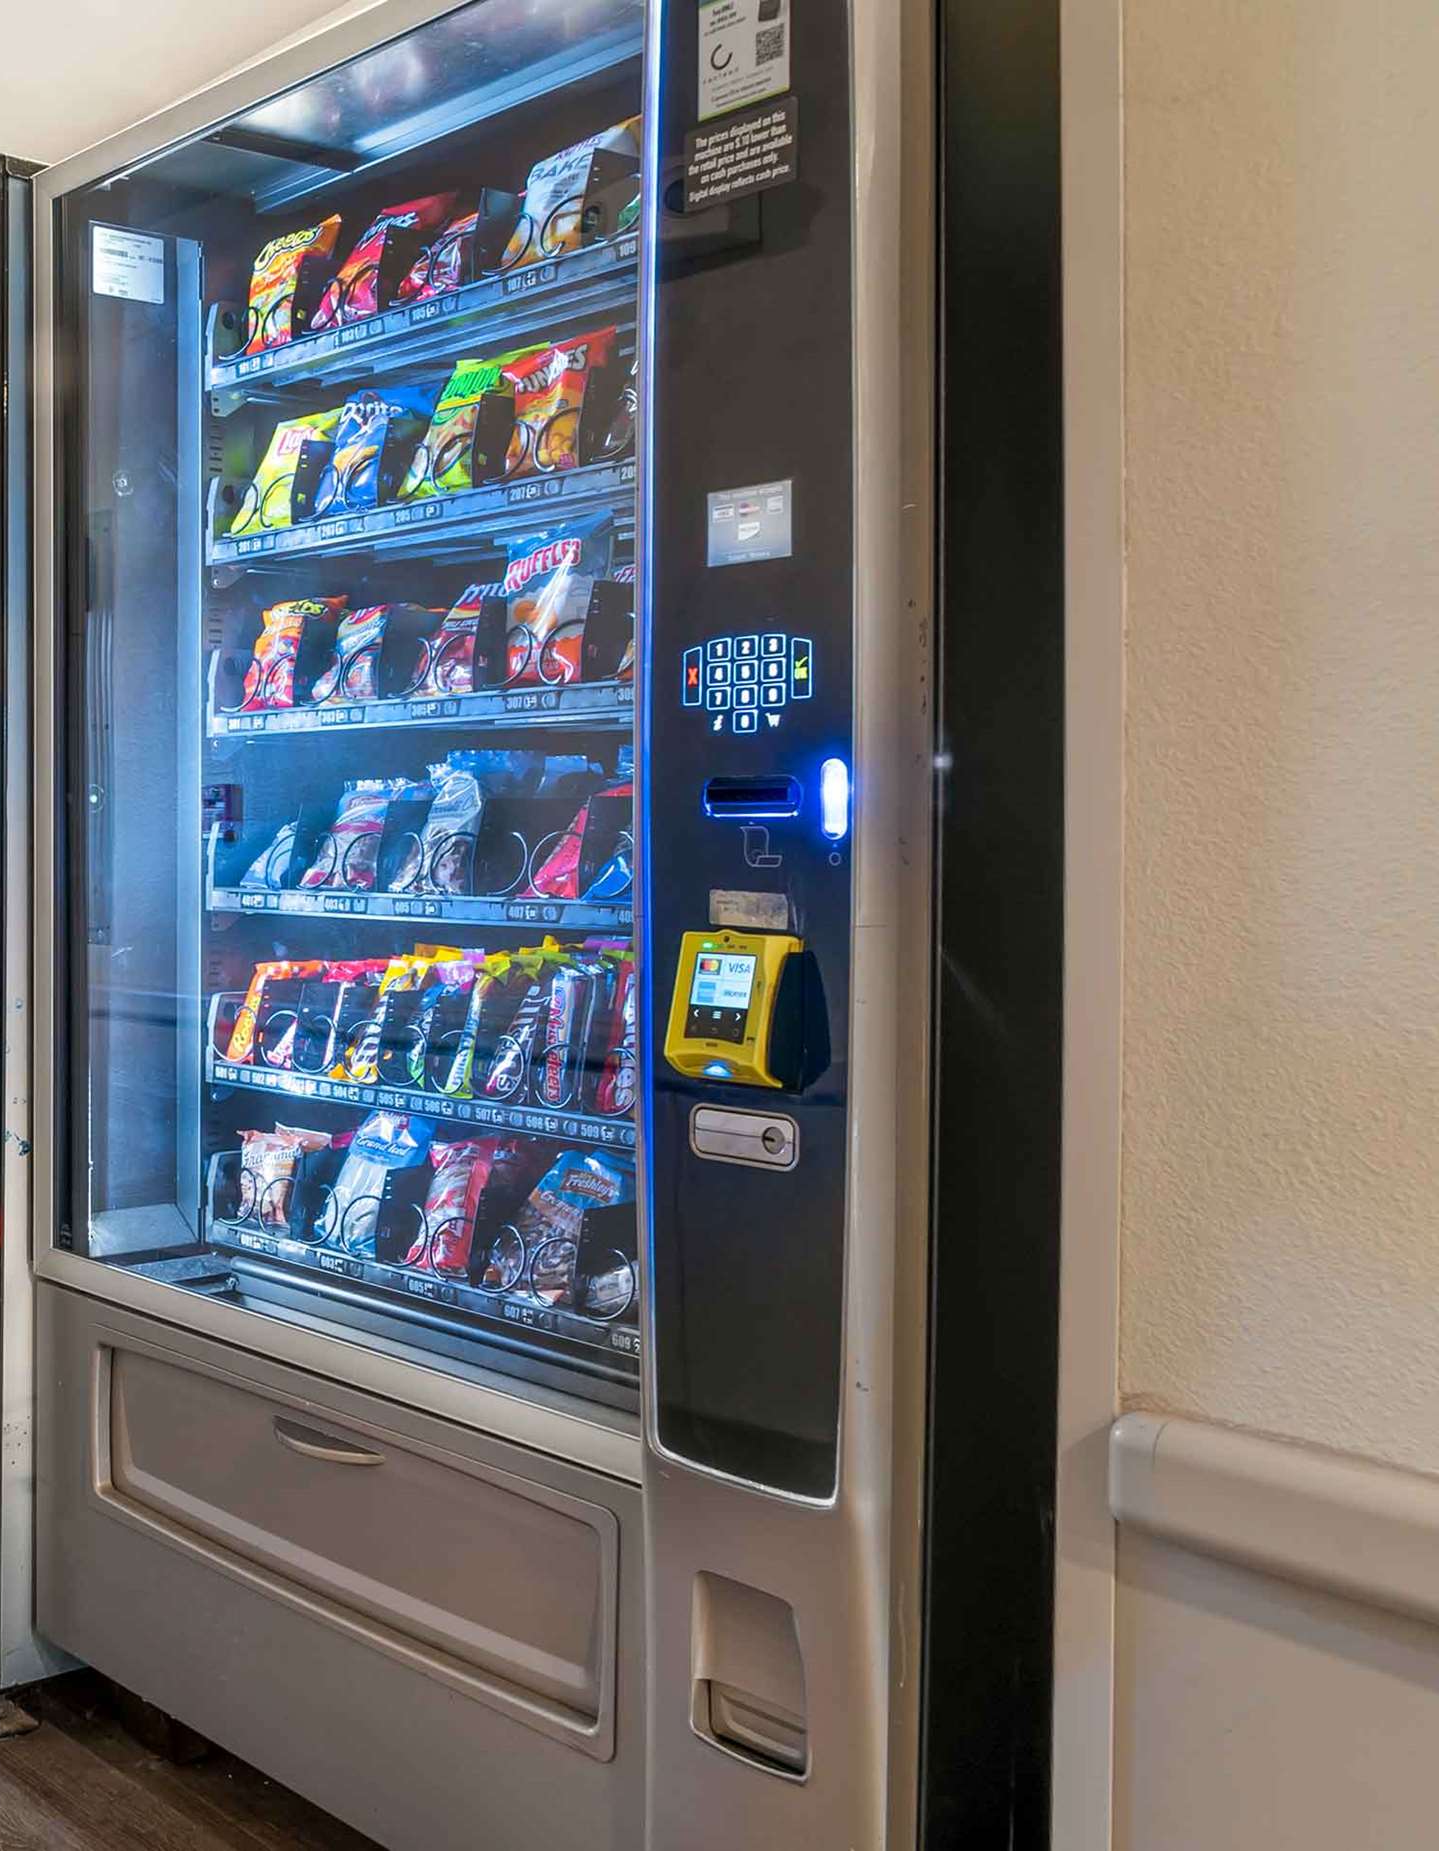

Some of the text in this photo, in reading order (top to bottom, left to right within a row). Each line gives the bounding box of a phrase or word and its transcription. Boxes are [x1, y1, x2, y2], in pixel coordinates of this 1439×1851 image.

[530, 153, 594, 184] BAKE
[621, 466, 636, 480] 20
[715, 638, 778, 656] 1 2 3
[714, 667, 724, 681] 4
[714, 691, 723, 706] 7
[741, 714, 750, 728] 0
[728, 962, 751, 974] VISA
[475, 1106, 491, 1120] 507
